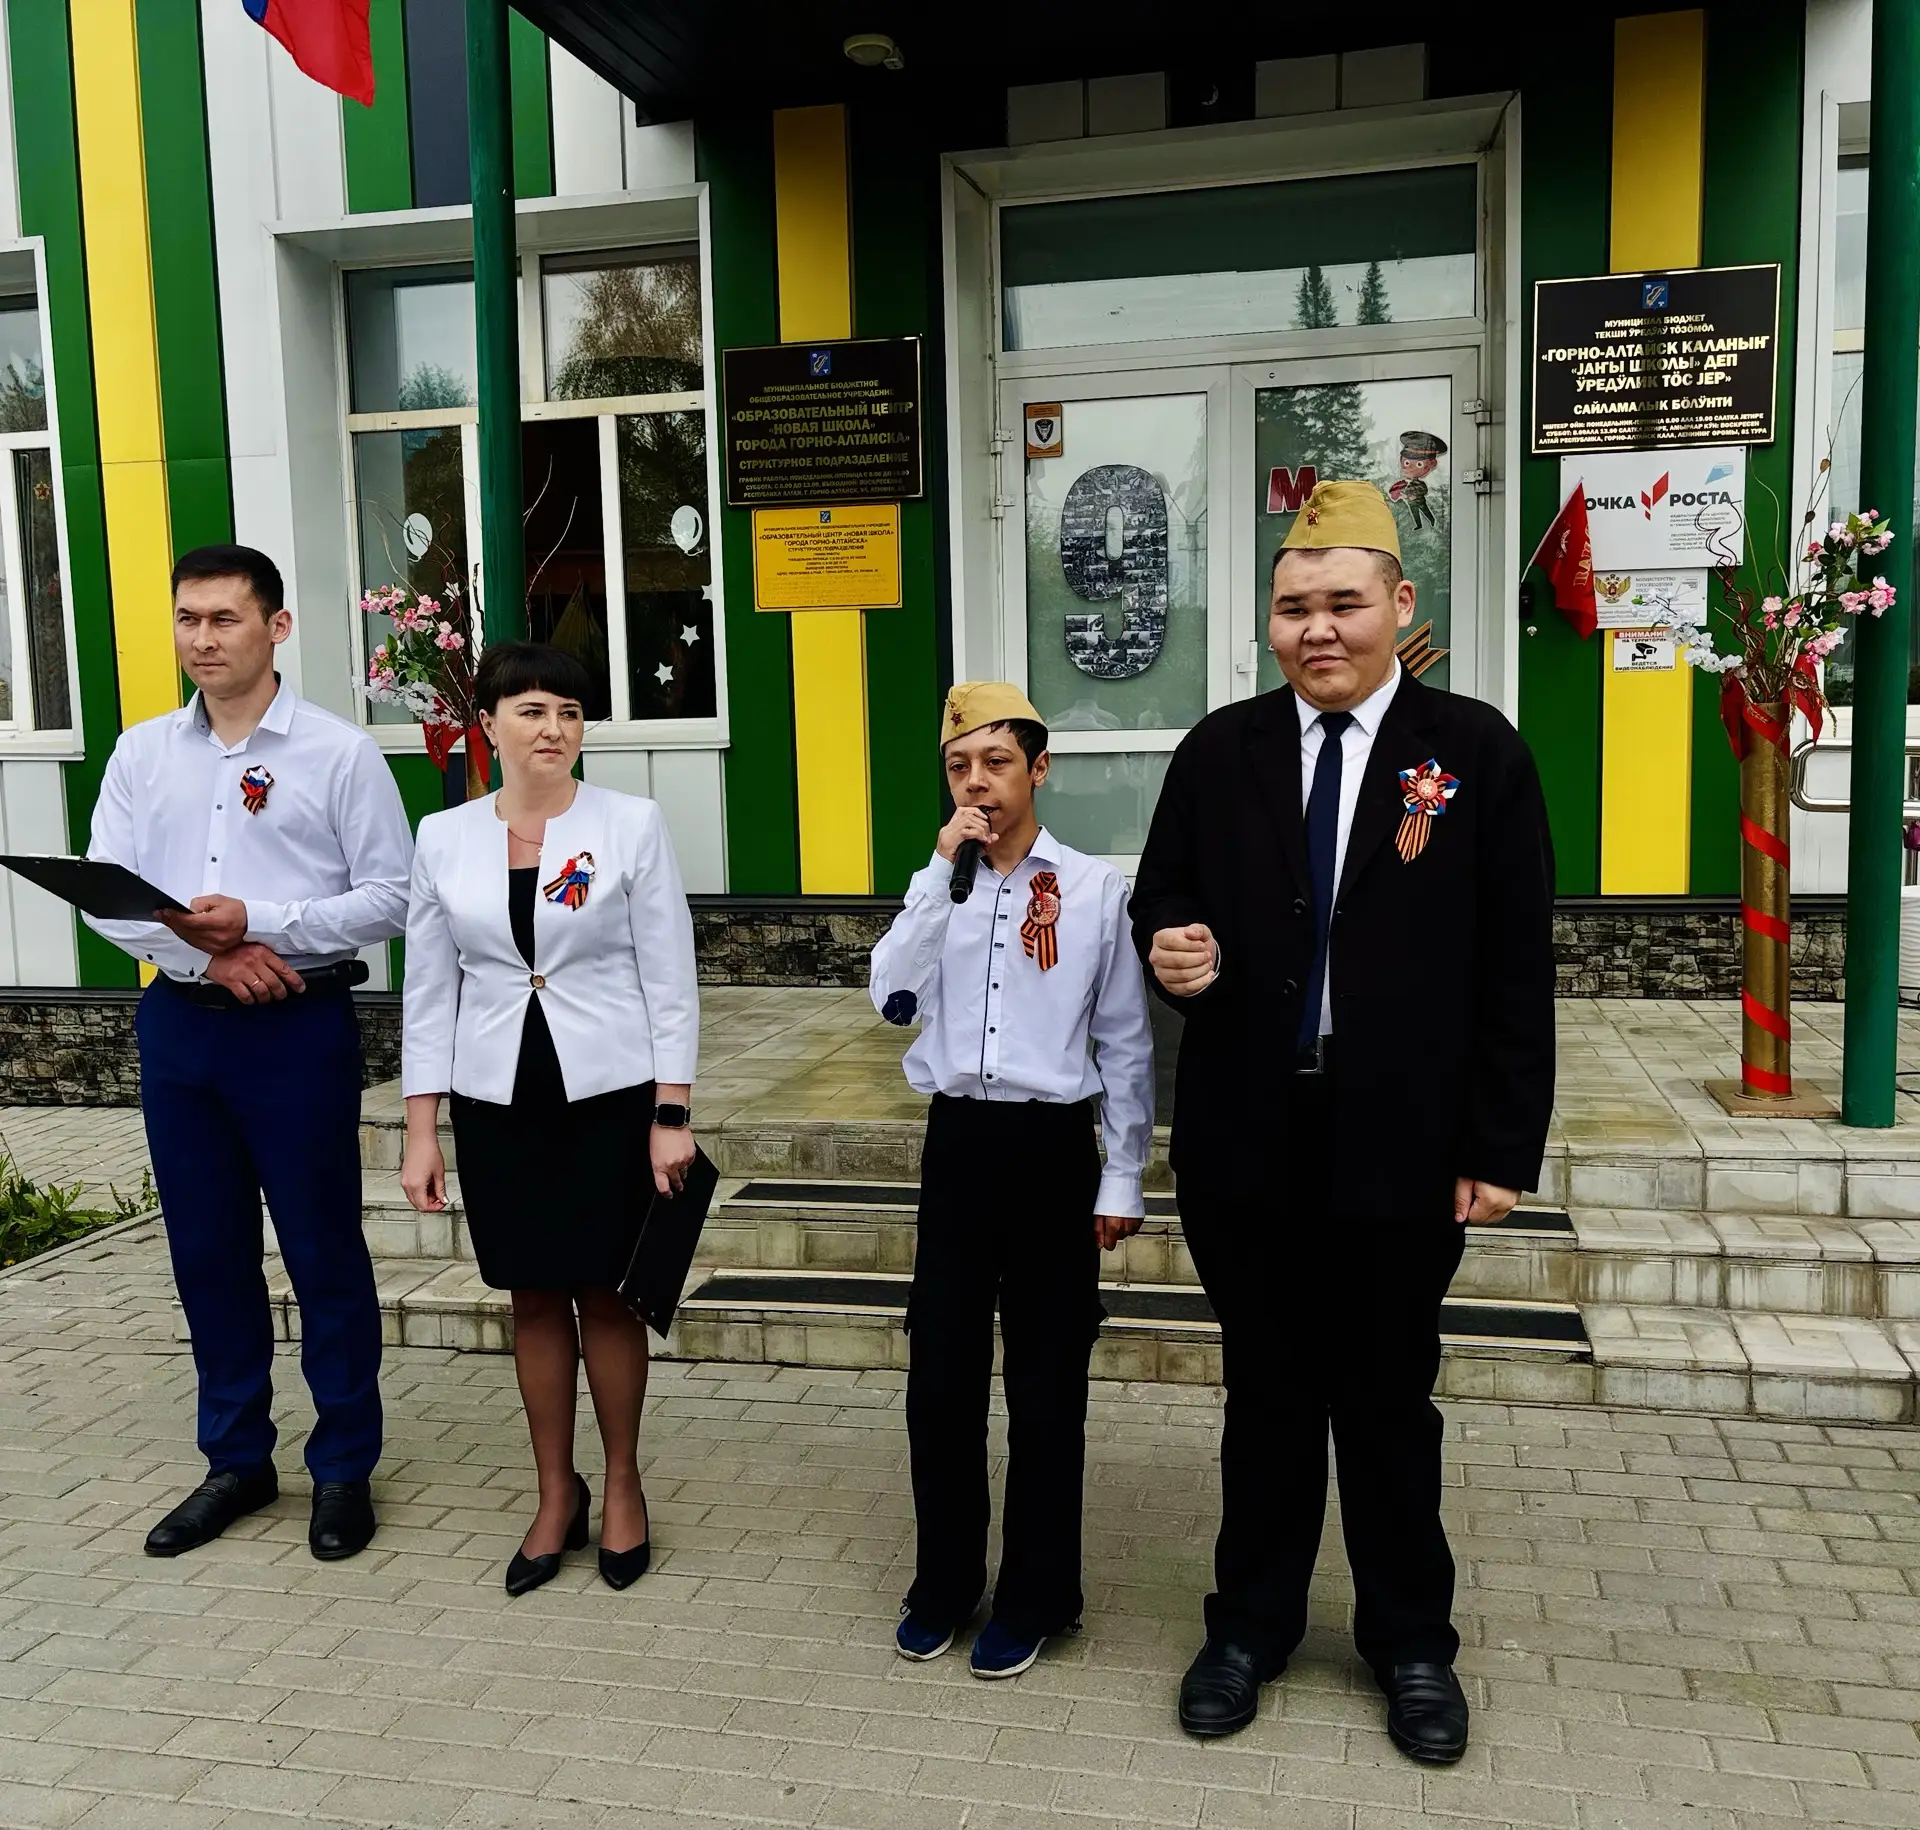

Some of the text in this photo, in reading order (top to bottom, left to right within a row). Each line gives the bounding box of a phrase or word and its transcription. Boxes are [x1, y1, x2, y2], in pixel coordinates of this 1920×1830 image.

[1604, 314, 1705, 328] МУНИЦИПАЛ БЮДЖЕТ
[1594, 329, 1627, 339] ТЕКШИ
[1541, 340, 1677, 362] «ГОРНО-АЛТАЙСК
[1629, 356, 1701, 372] ШКОЛЫ»
[1703, 354, 1738, 371] ДЕП
[763, 380, 879, 394] МУНИЦИПАЛЬНОЕ БЮДЖЕТНОЕ
[1661, 370, 1693, 388] ТӦС
[749, 388, 894, 403] ОБЩЕОБРАЗОВАТЕЛЬНОЕ УЧРЕЖДЕНИЕ
[731, 401, 914, 422] «ОБРАЗОВАТЕЛЬНЫЙ ЦЕНТР
[1573, 399, 1669, 415] САЙЛАМАЛЫК
[768, 418, 876, 434] «НОВАЯ ШКОЛА»
[735, 437, 787, 451] ГОРОДА
[1538, 436, 1559, 445] АЛТАЙ
[1751, 427, 1768, 435] ТУРА
[739, 452, 909, 470] СТРУКТУРНОЕ ПОДРАЗДЕЛЕНИЕ
[1584, 491, 1732, 511] ОЧКА РОСТА
[759, 529, 895, 541] «ОБРАЗОВАТЕЛЬНЫЙ ЦЕНТР «НОВАЯ ШКОЛА»
[809, 537, 868, 546] ГОРНО-АЛТАЙСКА»
[1061, 464, 1168, 679] 9
